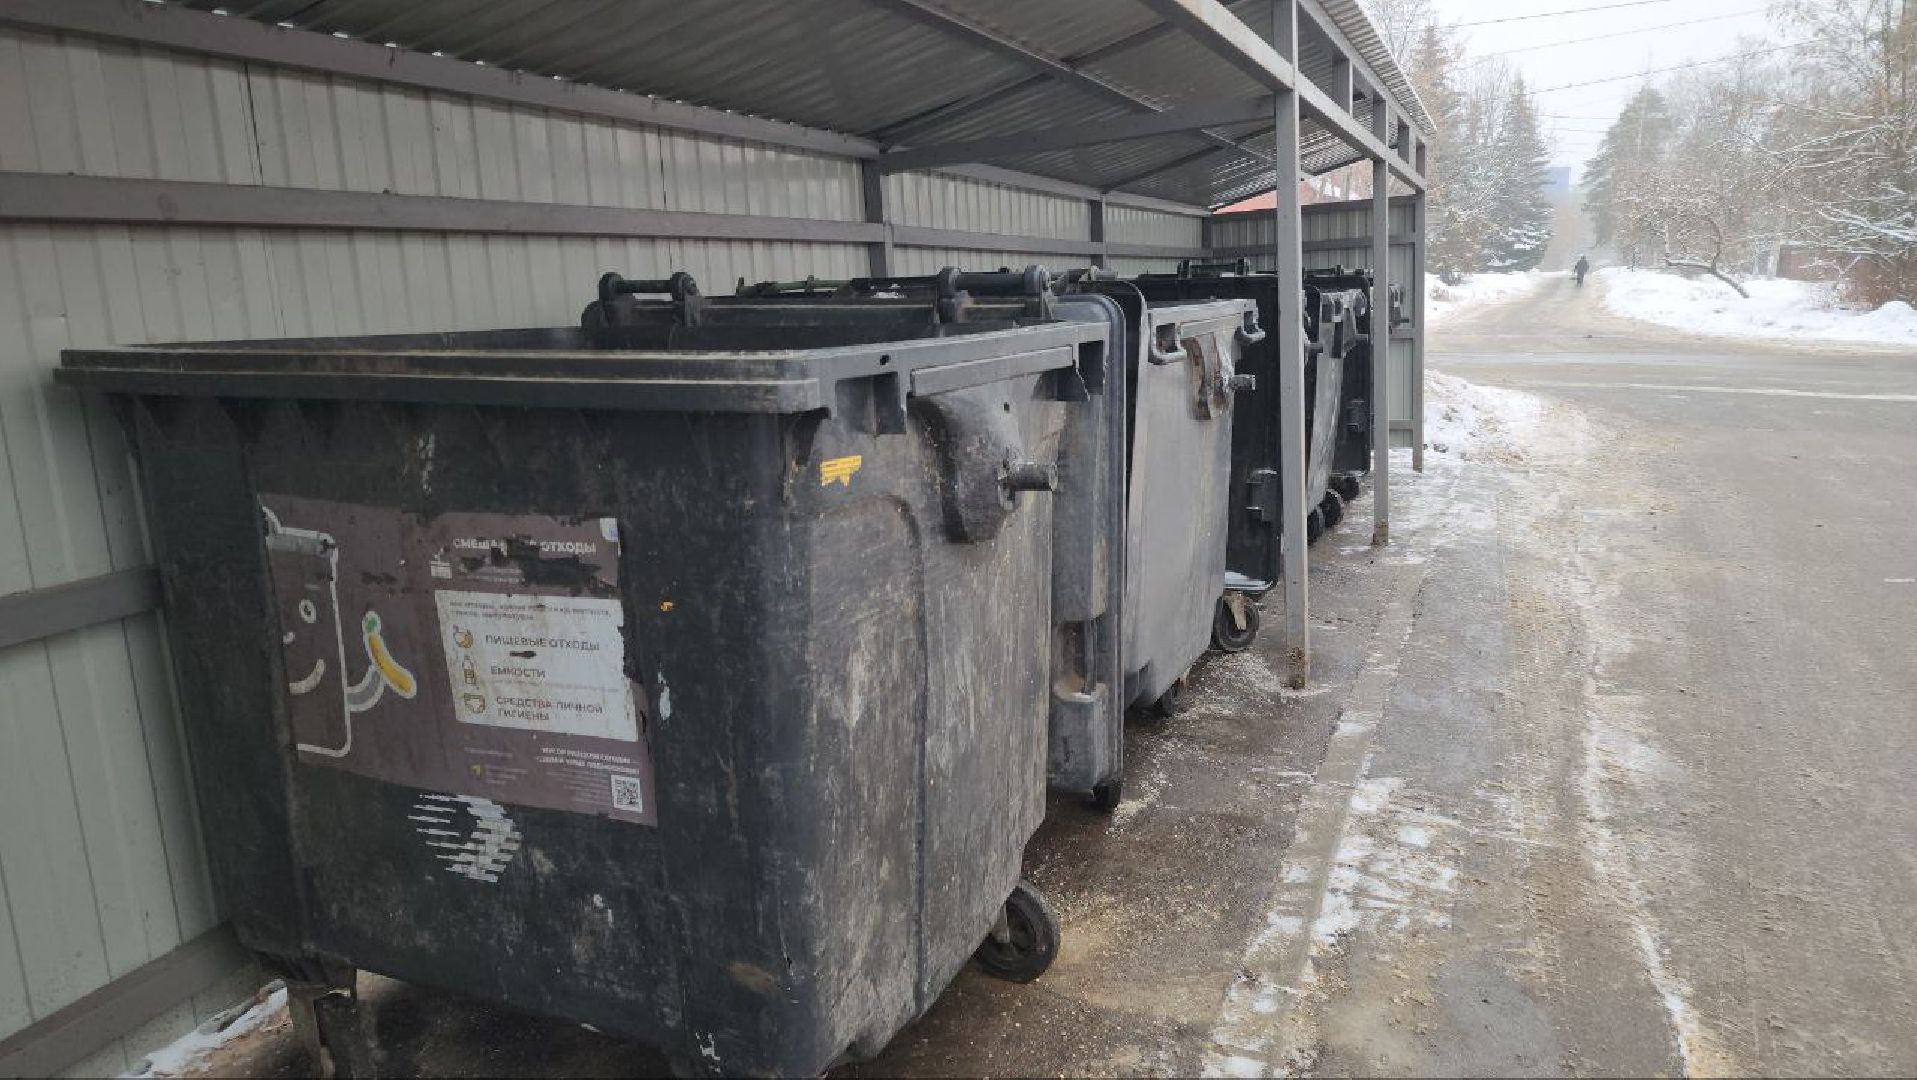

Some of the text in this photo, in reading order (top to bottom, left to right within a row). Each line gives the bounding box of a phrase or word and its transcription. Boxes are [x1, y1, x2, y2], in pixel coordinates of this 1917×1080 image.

[540, 541, 598, 555] ОТХОДЫ
[485, 634, 600, 651] ПИЩЕВЫЕ ОТХОДЫ
[490, 665, 546, 678] ЕМКОСТИ
[496, 696, 603, 715] СРЕДСТВА ЛИЧНОЙ
[498, 709, 550, 721] ГИГИЕНЫ
